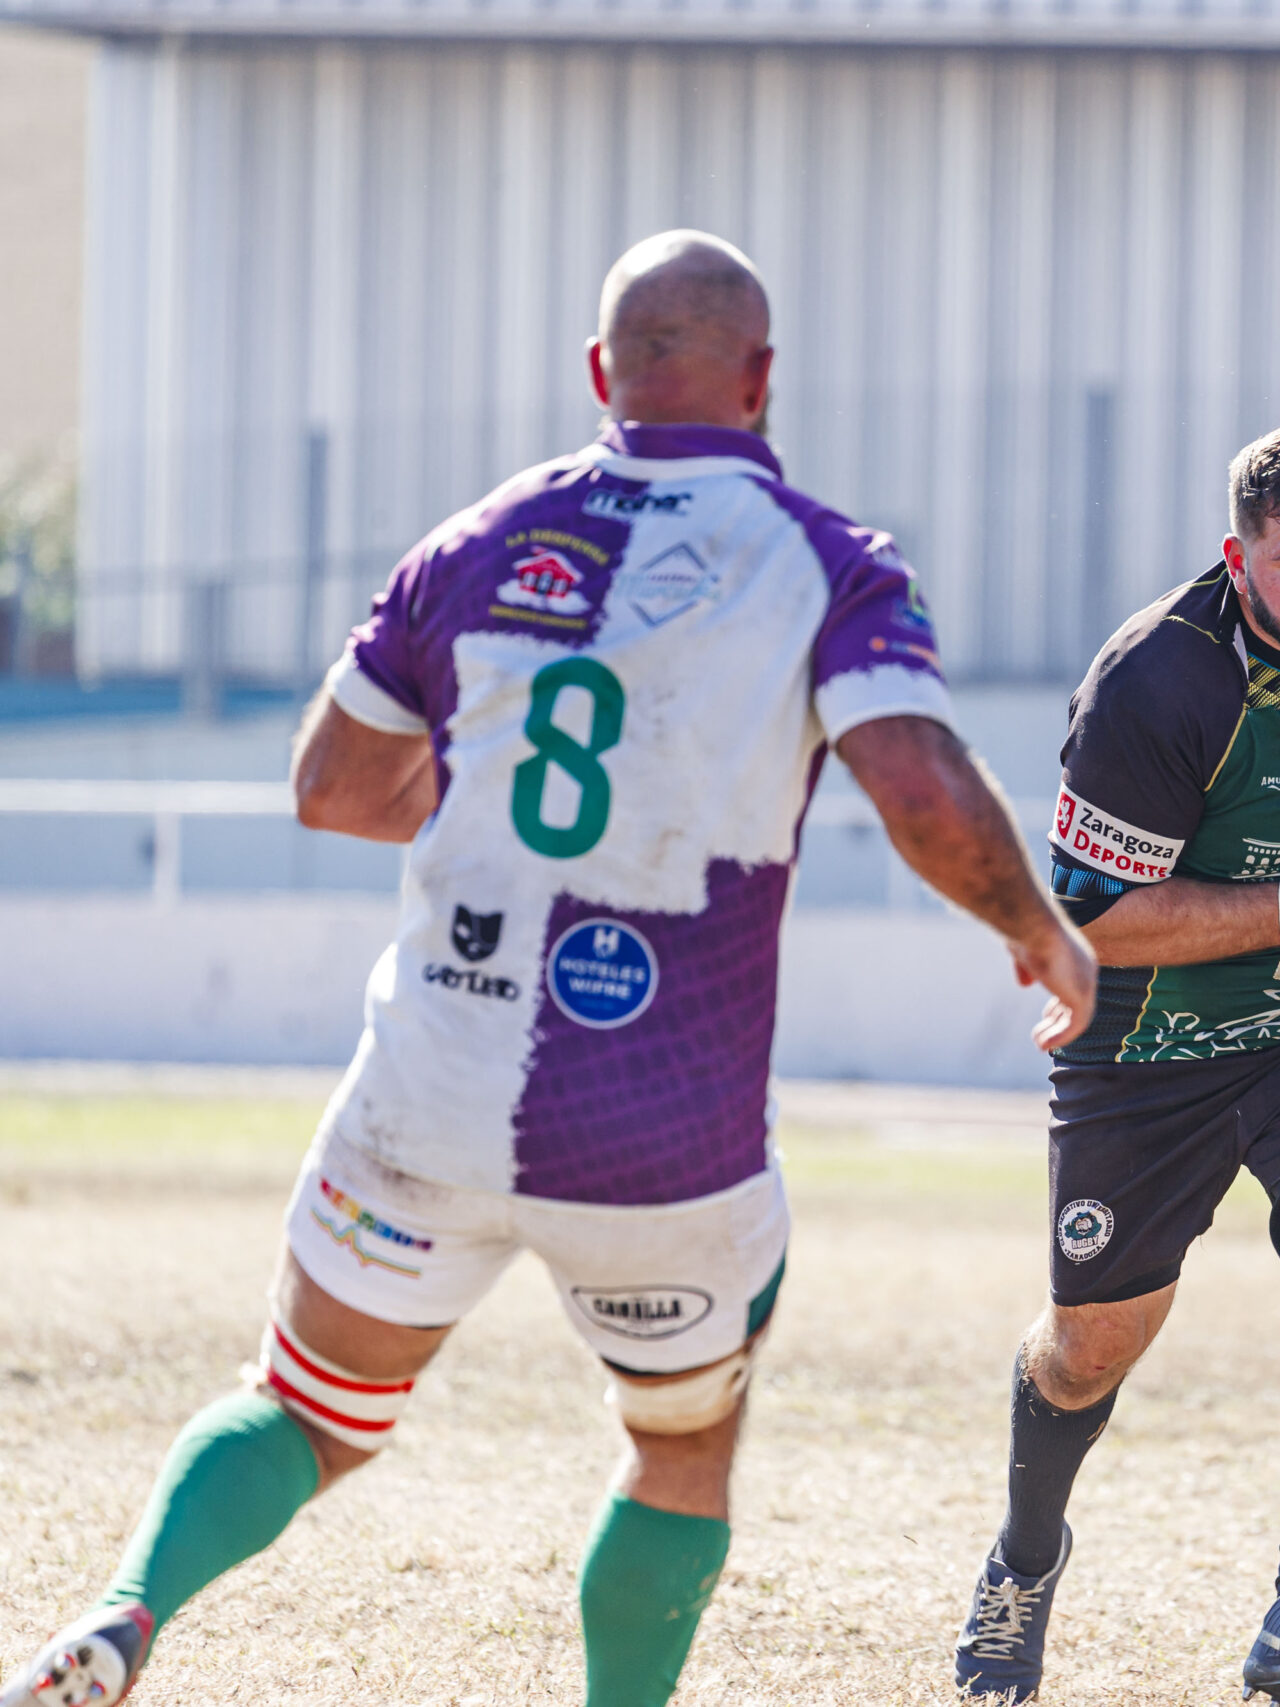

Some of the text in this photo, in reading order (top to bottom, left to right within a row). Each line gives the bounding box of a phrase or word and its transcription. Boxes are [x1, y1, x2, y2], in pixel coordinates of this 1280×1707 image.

[511, 656, 626, 859] 8
[1073, 829, 1168, 878] DEPORTE
[1080, 807, 1175, 859] Zaragoza
[558, 956, 647, 984] HOTELES
[1071, 1235, 1100, 1250] RUGBY
